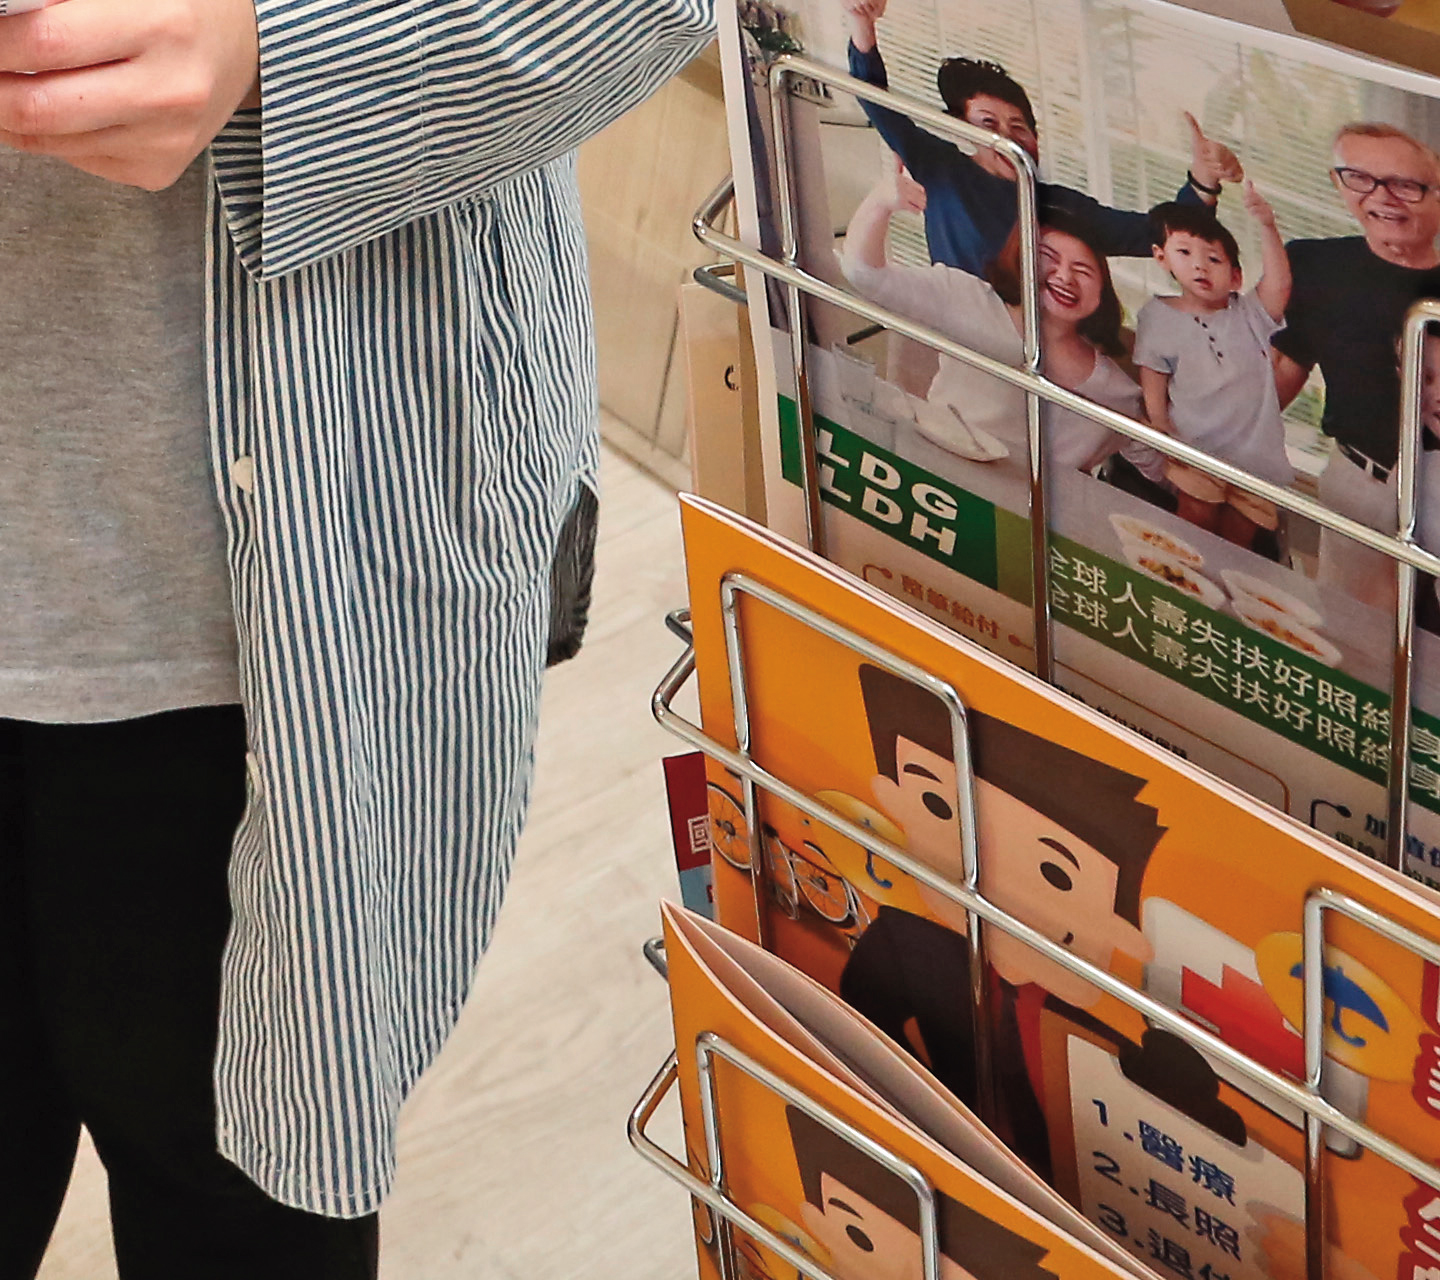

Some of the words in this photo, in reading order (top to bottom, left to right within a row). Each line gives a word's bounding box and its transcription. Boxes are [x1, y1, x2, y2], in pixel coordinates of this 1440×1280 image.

[817, 428, 959, 522] LDG
[819, 463, 957, 557] LDH
[1092, 1098, 1236, 1207] 1.醫療
[1092, 1151, 1242, 1263] 2.長照
